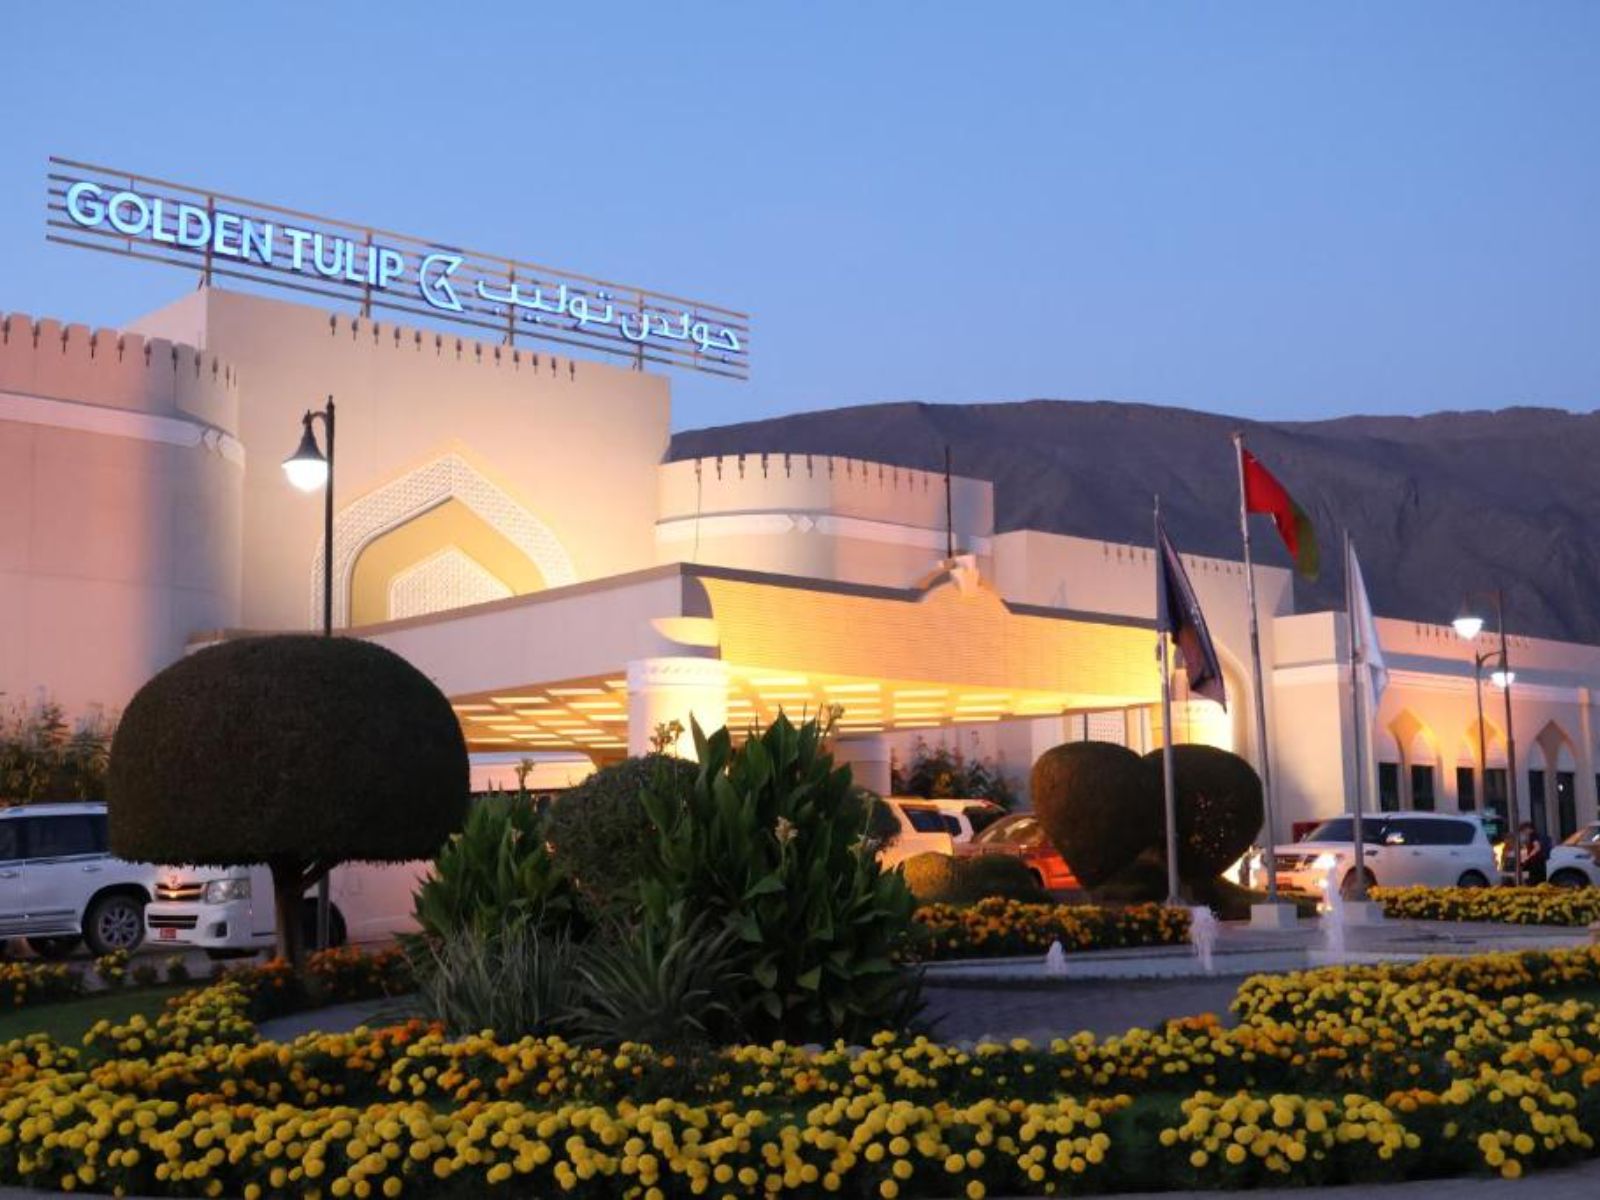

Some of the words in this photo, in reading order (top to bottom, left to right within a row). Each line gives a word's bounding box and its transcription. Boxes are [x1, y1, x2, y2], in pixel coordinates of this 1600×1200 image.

[66, 182, 273, 265] GOLDEN
[284, 227, 403, 287] TULIP
[477, 280, 613, 325] توليب
